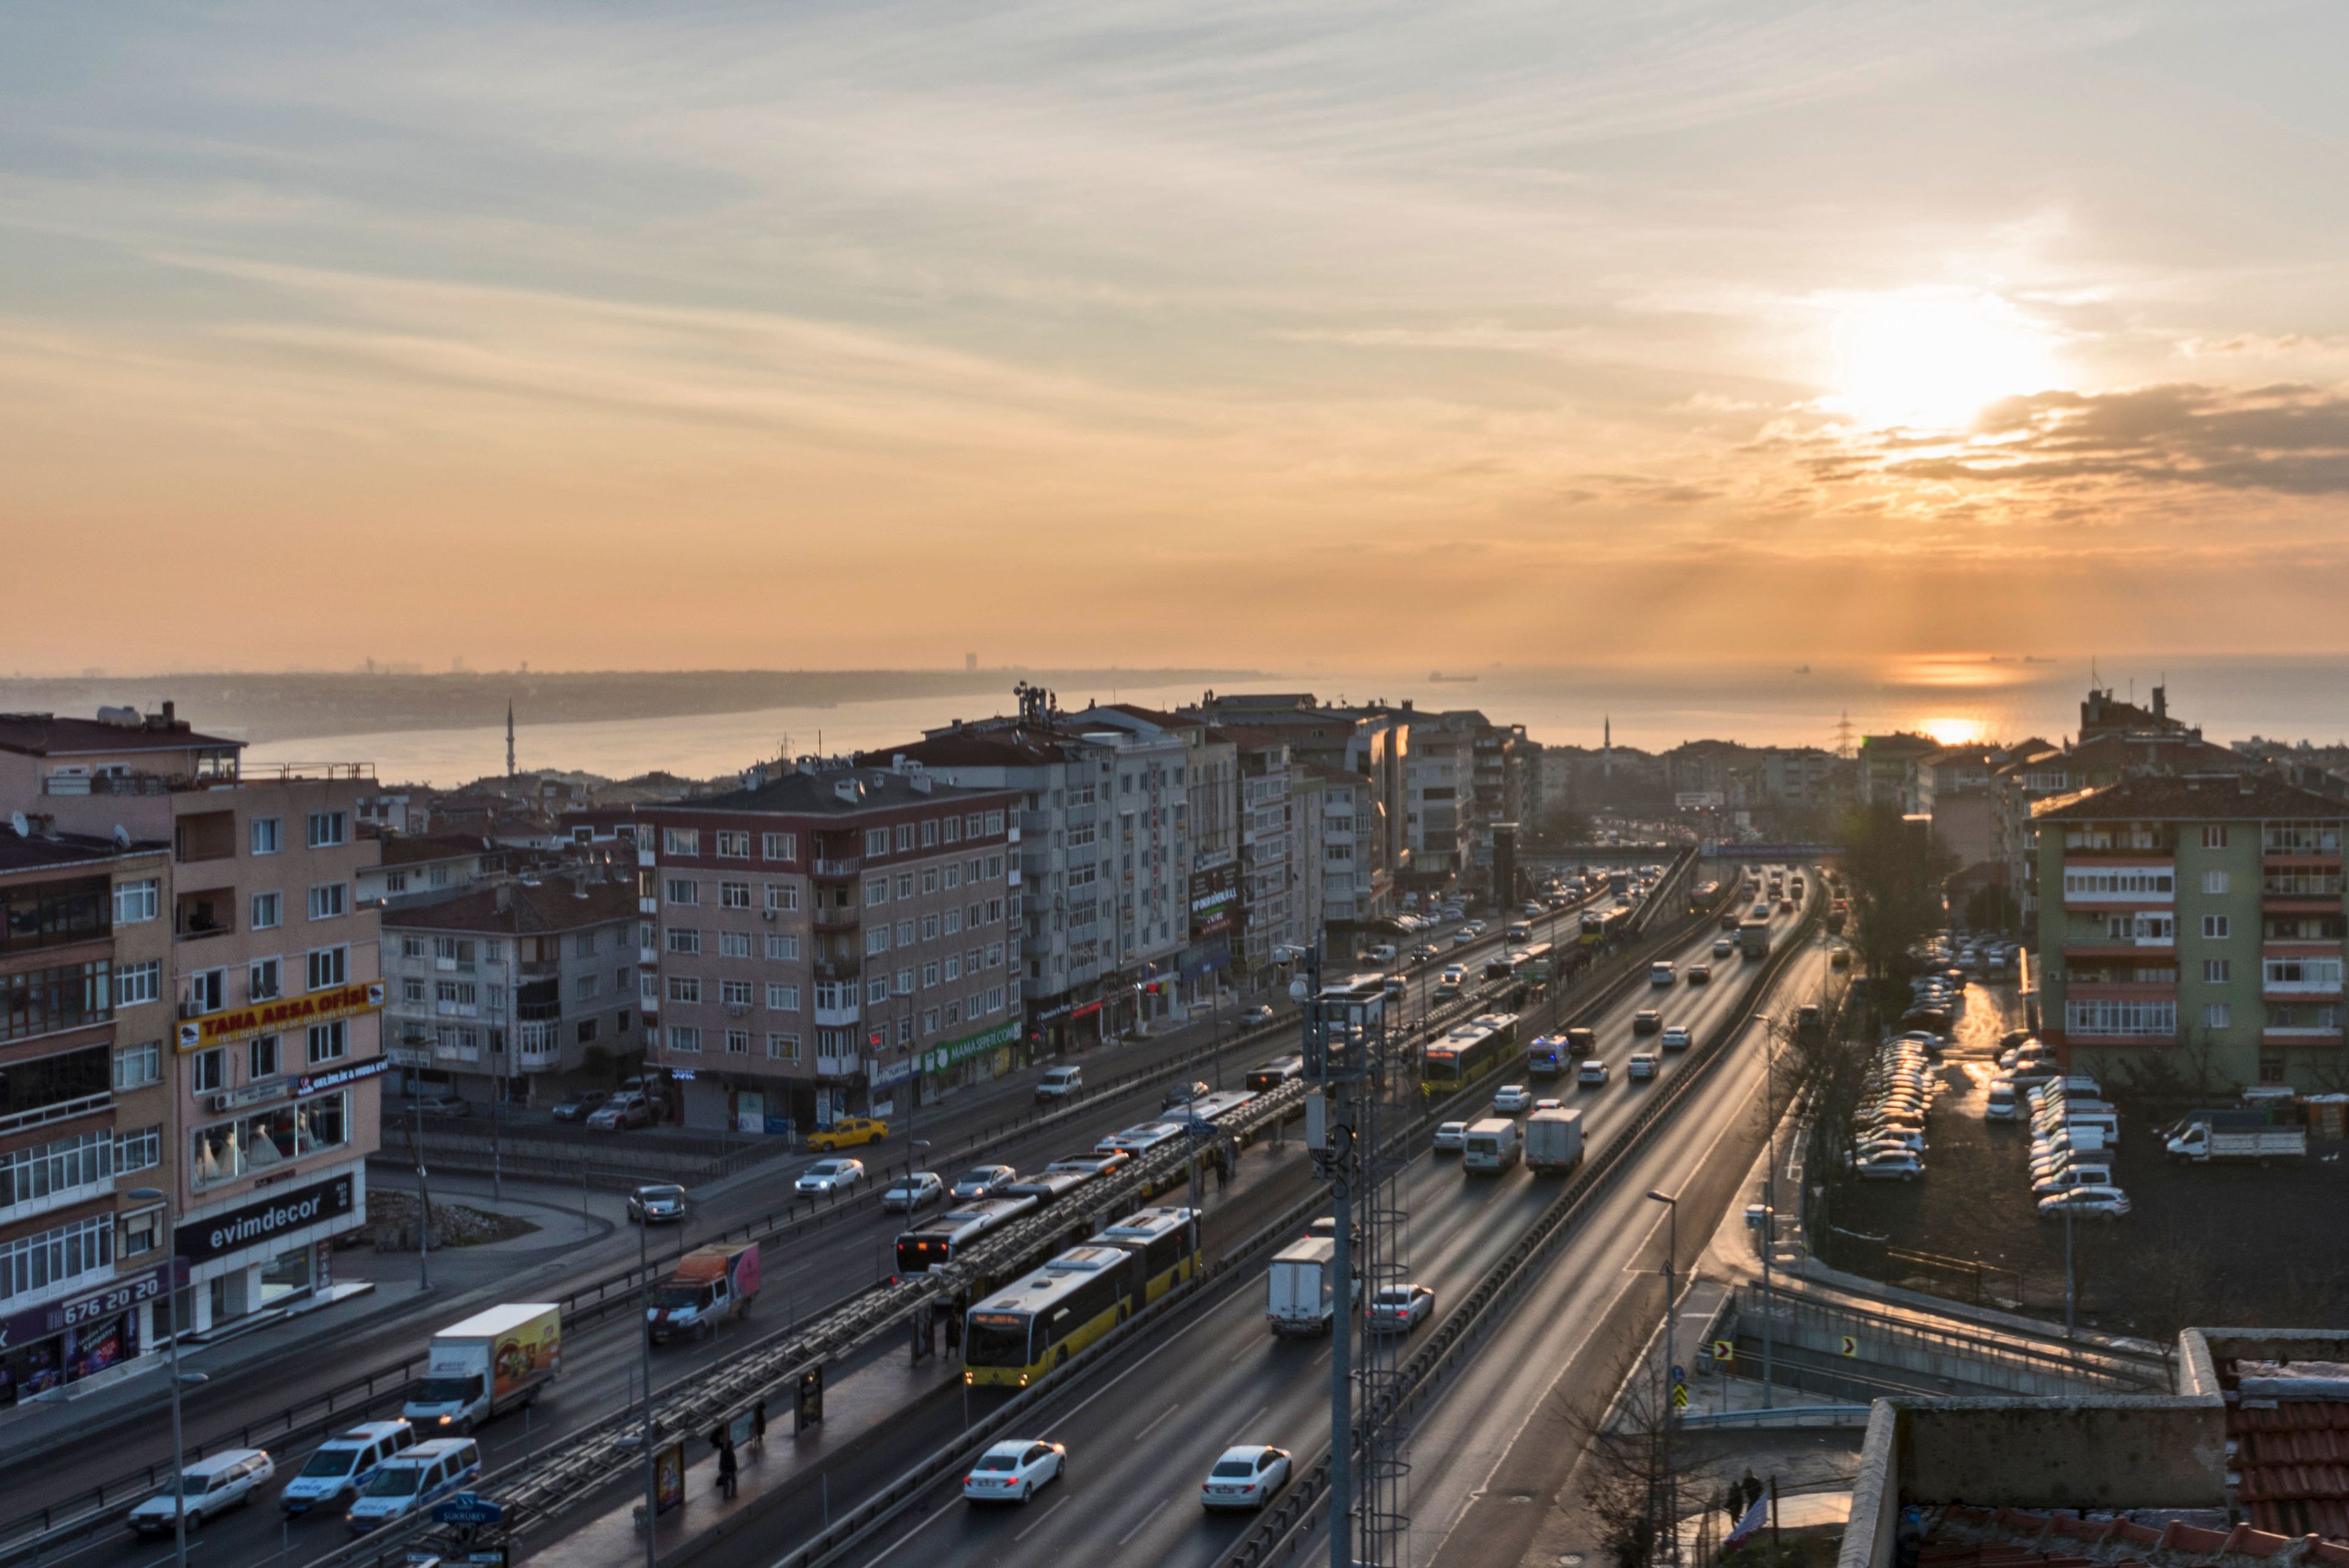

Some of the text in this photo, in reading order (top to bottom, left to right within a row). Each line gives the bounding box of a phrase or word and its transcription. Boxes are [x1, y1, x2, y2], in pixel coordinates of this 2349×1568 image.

[202, 984, 368, 1037] TAHA ARSA OFİSİ
[210, 1198, 319, 1248] evimdecor
[65, 1299, 100, 1325] 676
[105, 1288, 130, 1310] 20
[135, 1279, 158, 1299] 20
